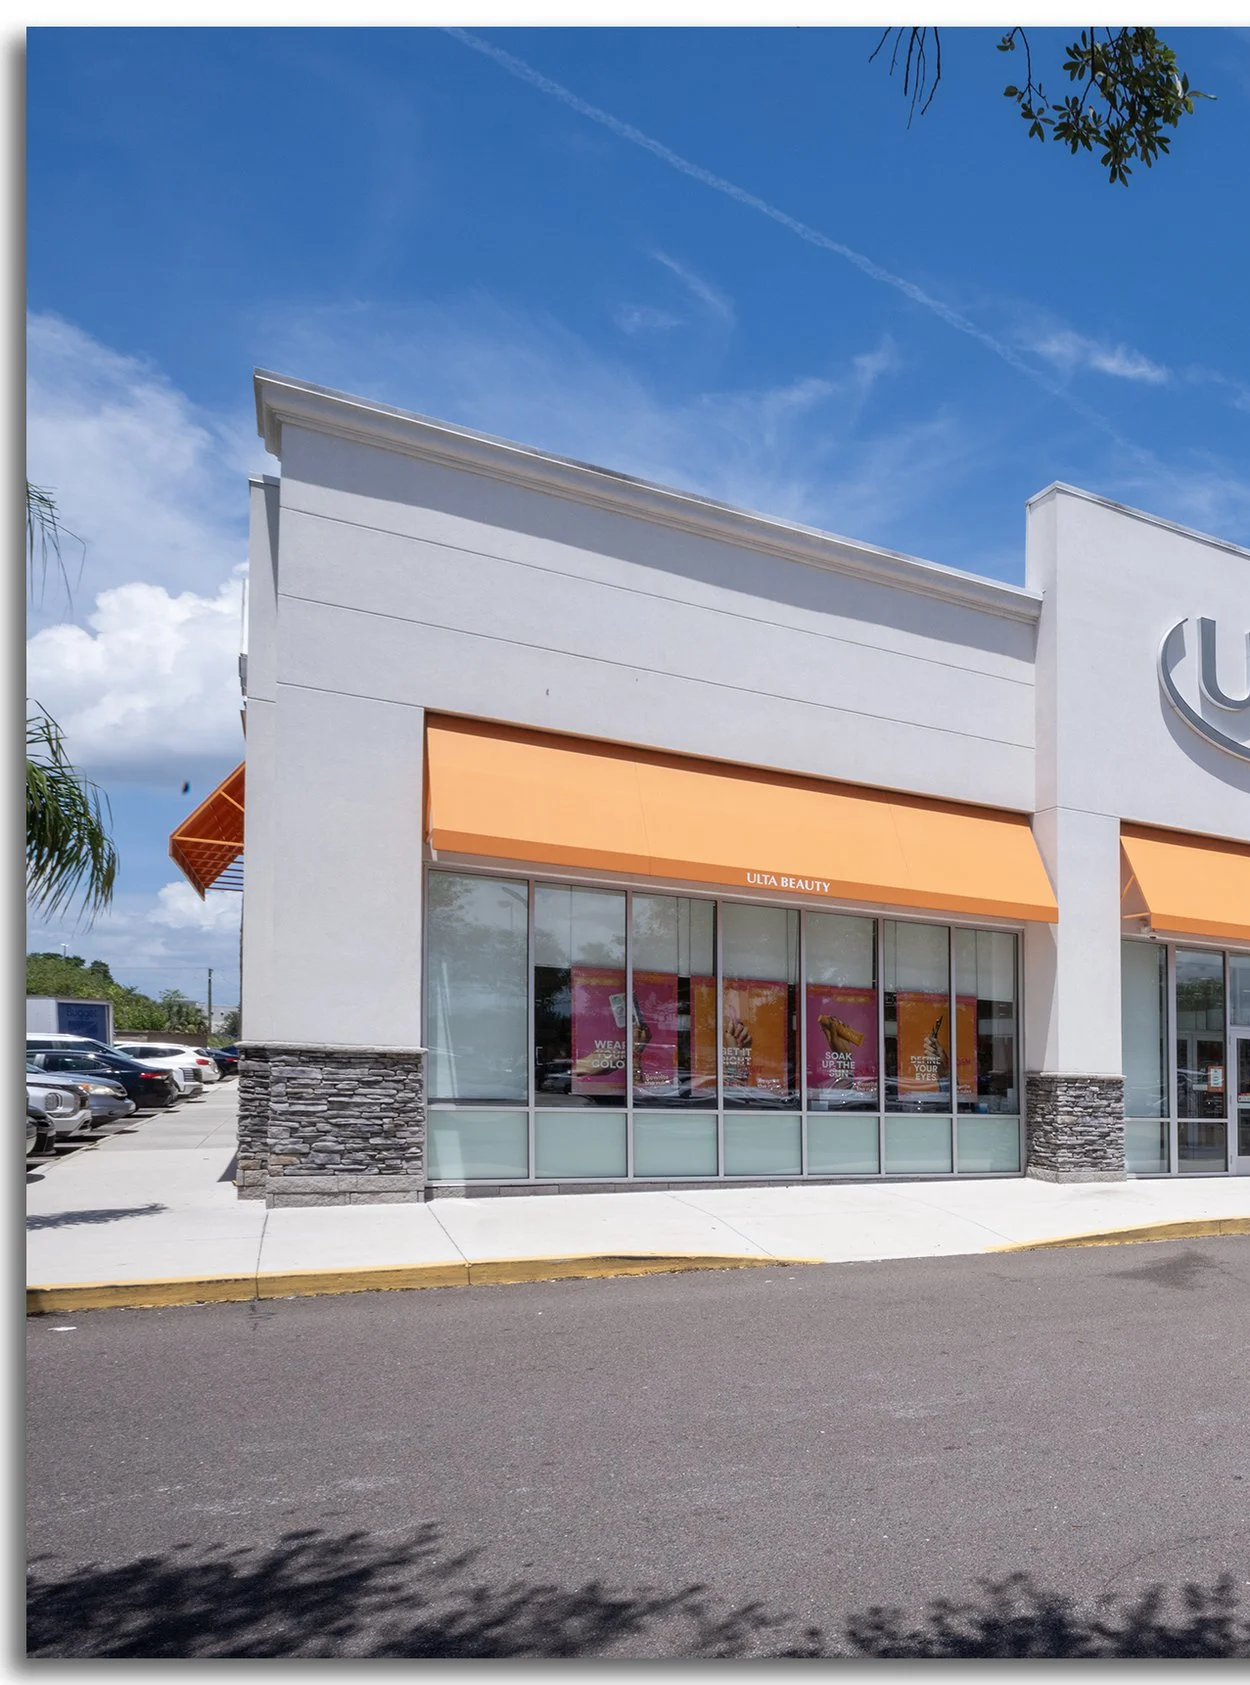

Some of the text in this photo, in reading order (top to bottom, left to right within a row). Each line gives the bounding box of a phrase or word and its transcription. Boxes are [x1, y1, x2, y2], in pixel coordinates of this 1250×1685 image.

[746, 871, 830, 893] ULTA BEAUTY
[825, 1052, 852, 1060] SOAK
[910, 1056, 941, 1065] DEFINE
[591, 1060, 625, 1069] COLO
[822, 1060, 856, 1070] UP THE
[914, 1064, 938, 1073] YOUR
[828, 1070, 850, 1078] SUN
[916, 1073, 937, 1081] EYES
